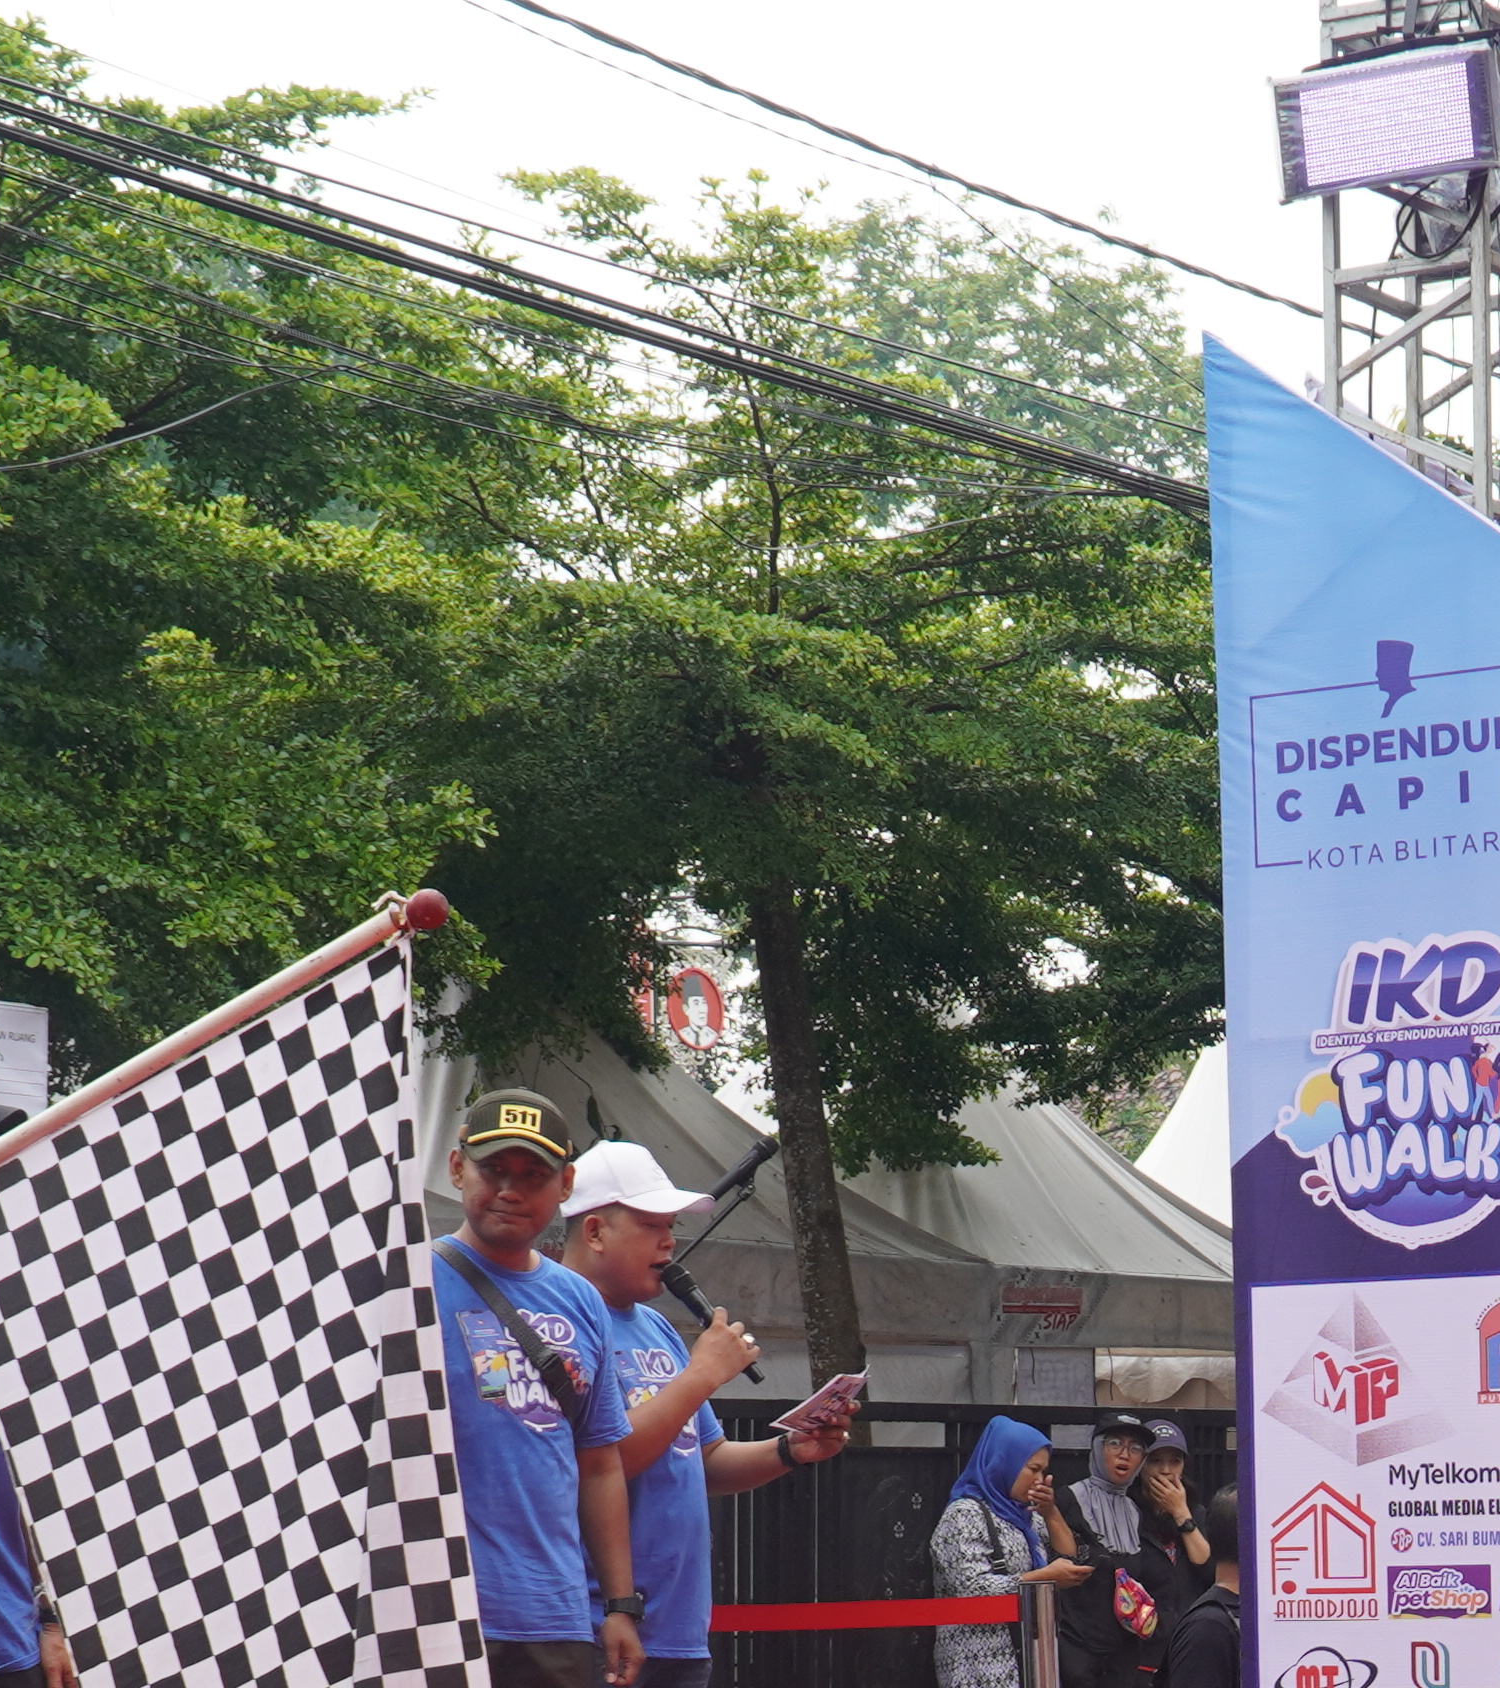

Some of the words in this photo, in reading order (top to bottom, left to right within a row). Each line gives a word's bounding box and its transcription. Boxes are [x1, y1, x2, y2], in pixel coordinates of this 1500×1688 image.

[1308, 842, 1384, 869] KOTA
[1394, 831, 1500, 861] BLITAR
[9, 1031, 36, 1044] RUANG
[1316, 1031, 1374, 1048] IDENTITAS
[1375, 1024, 1469, 1043] KEPENDUDUKAN
[1336, 1052, 1471, 1128] FUN
[504, 1108, 537, 1127] 511
[1043, 1313, 1078, 1331] SIAP
[632, 1348, 677, 1378] IKD
[1388, 1501, 1438, 1517] GLOBAL
[1442, 1500, 1485, 1516] MEDIA
[1417, 1533, 1436, 1547] CV.
[1440, 1531, 1468, 1546] SARI
[1419, 1570, 1460, 1588] Baik
[1273, 1598, 1378, 1618] ATMODJOJO
[1394, 1588, 1486, 1614] petShop
